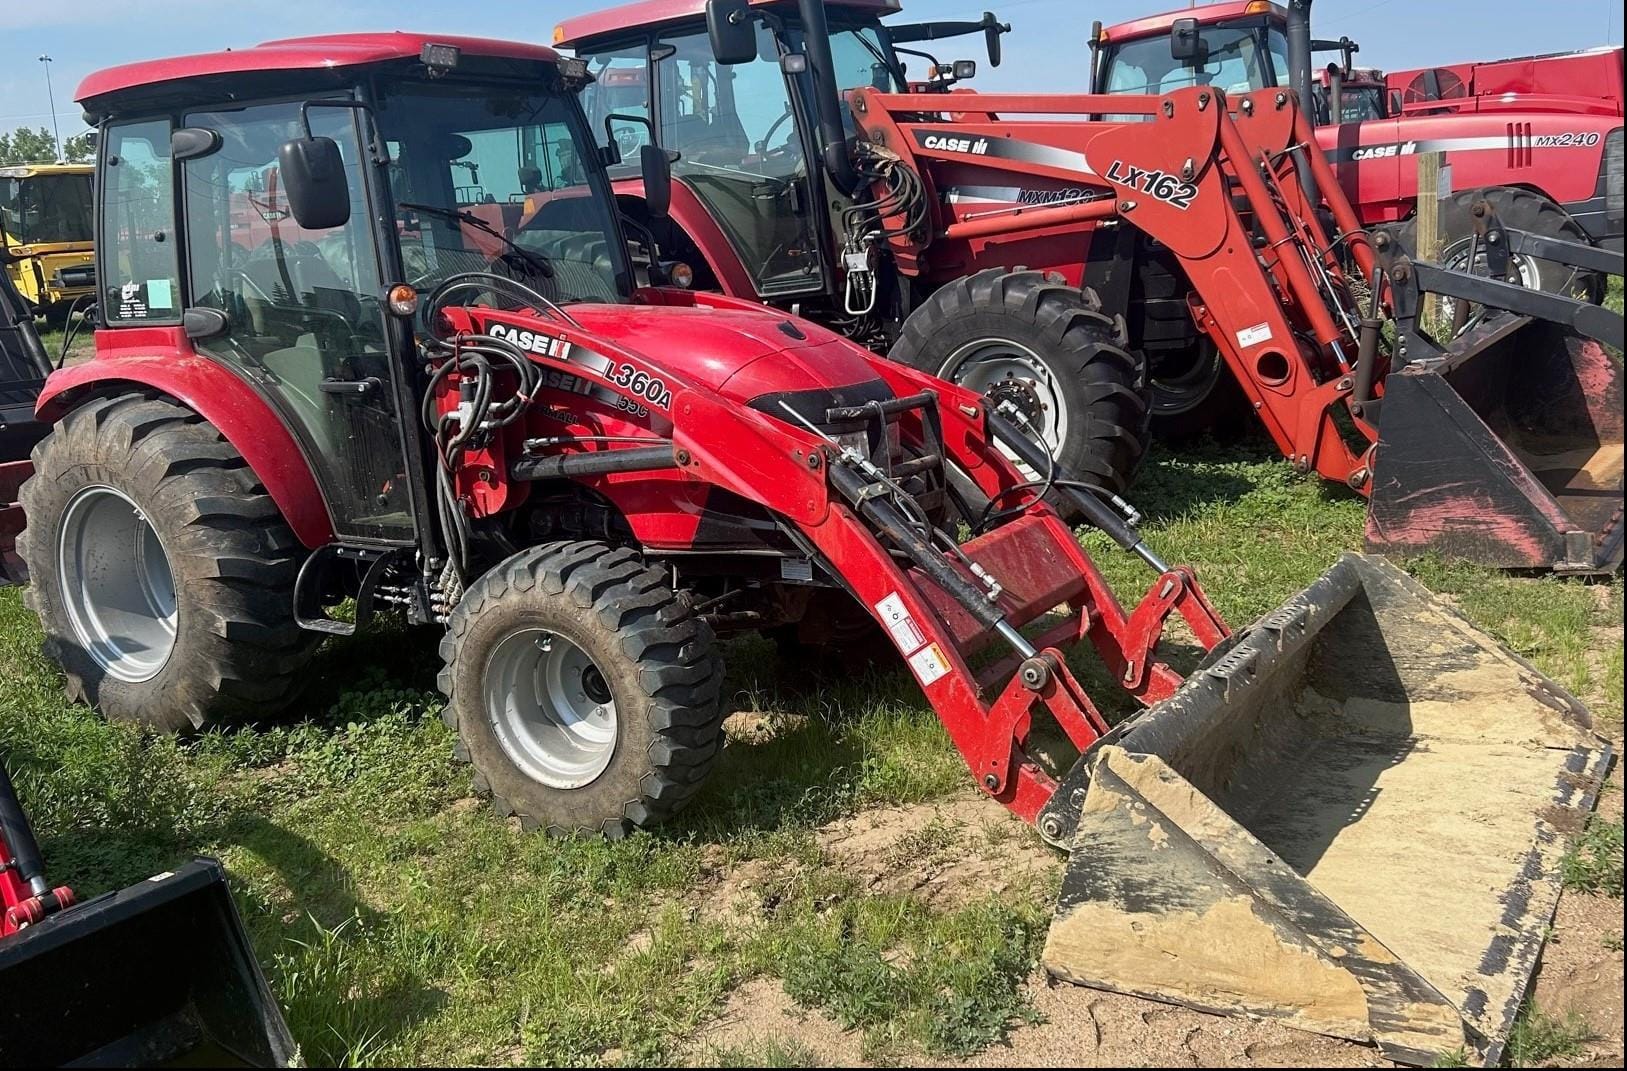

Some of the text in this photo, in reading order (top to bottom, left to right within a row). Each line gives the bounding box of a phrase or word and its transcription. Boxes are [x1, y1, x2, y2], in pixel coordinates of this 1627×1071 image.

[925, 136, 971, 153] CASE
[1535, 132, 1601, 148] MX240
[1352, 146, 1397, 161] CASE
[1105, 160, 1199, 211] LX162
[489, 324, 550, 355] CASE
[603, 360, 673, 411] L360A
